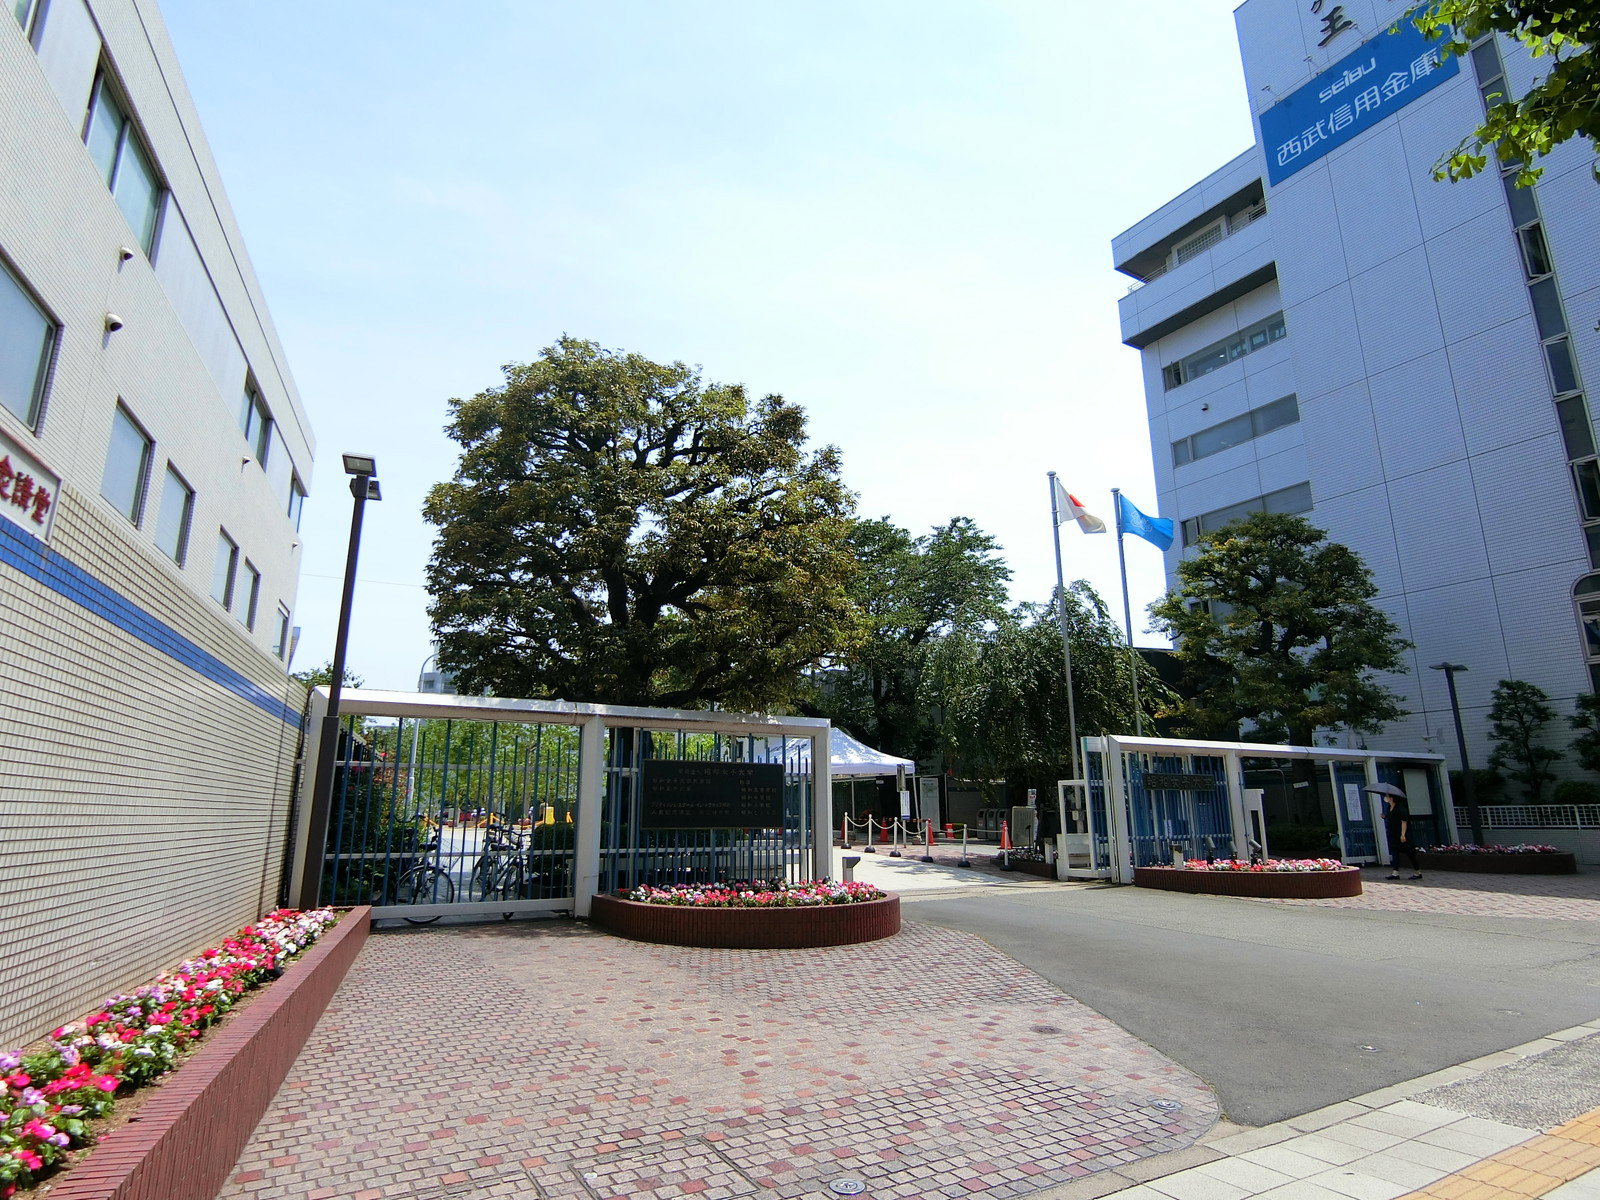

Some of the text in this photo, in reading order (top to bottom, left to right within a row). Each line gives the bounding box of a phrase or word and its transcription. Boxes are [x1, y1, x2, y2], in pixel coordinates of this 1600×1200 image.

[1277, 47, 1437, 167] 西武信用金庫
[1146, 775, 1212, 789] 昭和女子大学
